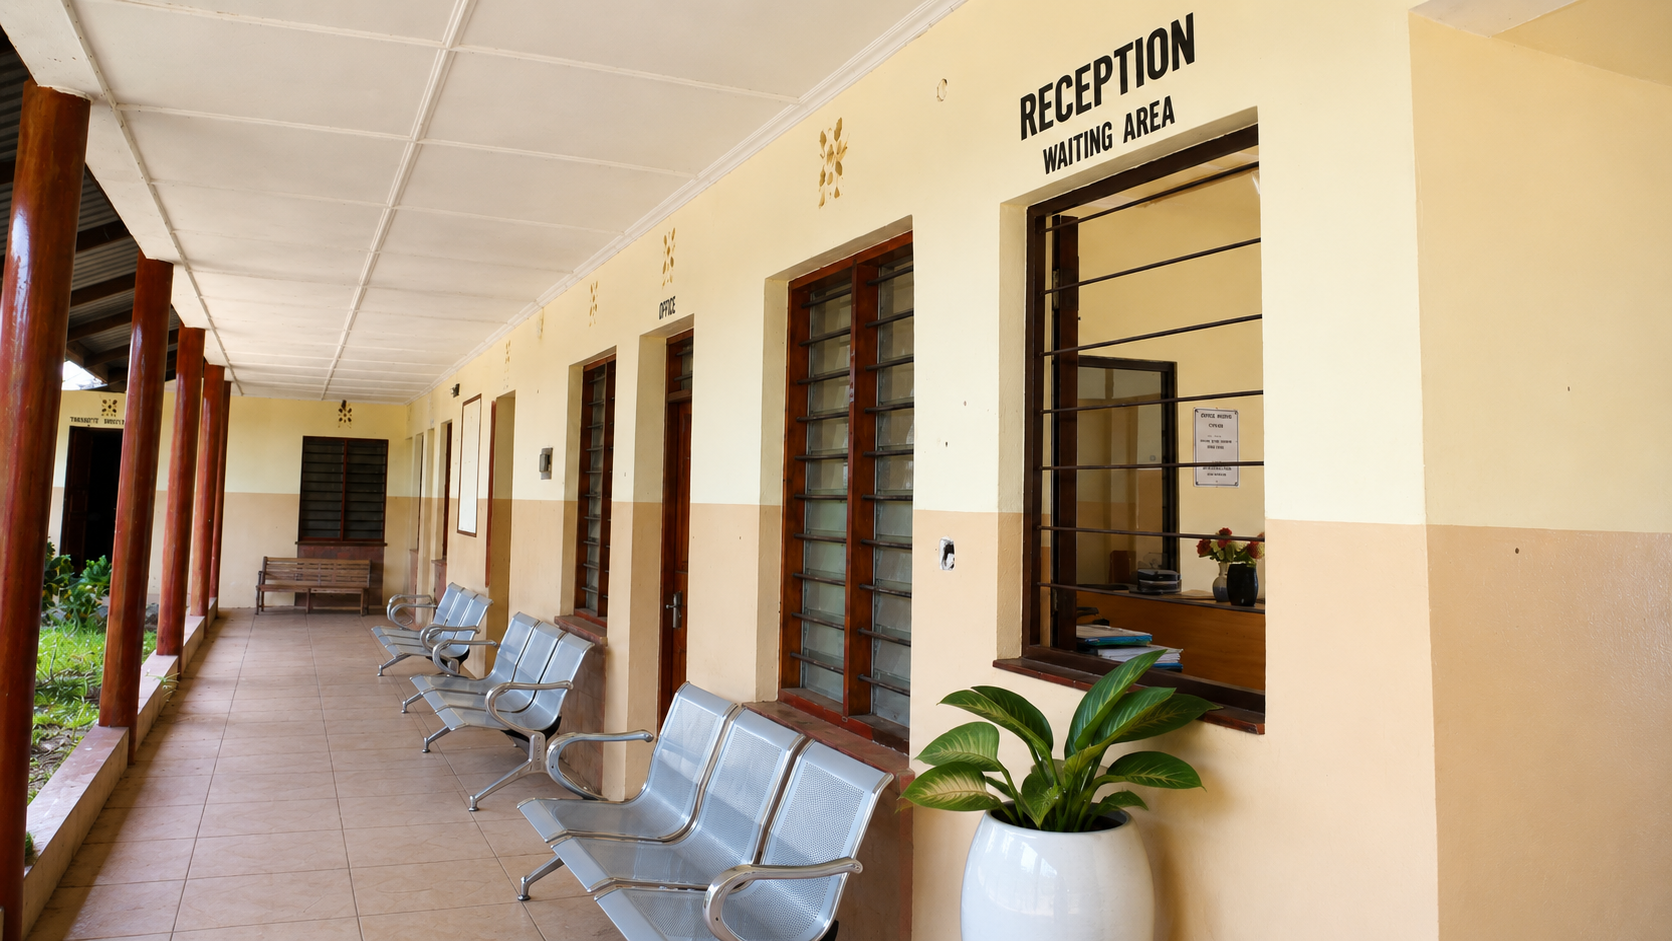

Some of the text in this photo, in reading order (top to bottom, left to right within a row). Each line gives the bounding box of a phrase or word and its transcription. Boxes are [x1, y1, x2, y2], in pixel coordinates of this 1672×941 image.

[1020, 12, 1195, 141] RECEPTION
[1043, 95, 1176, 175] WAITING AREA
[659, 295, 676, 320] OFFICE
